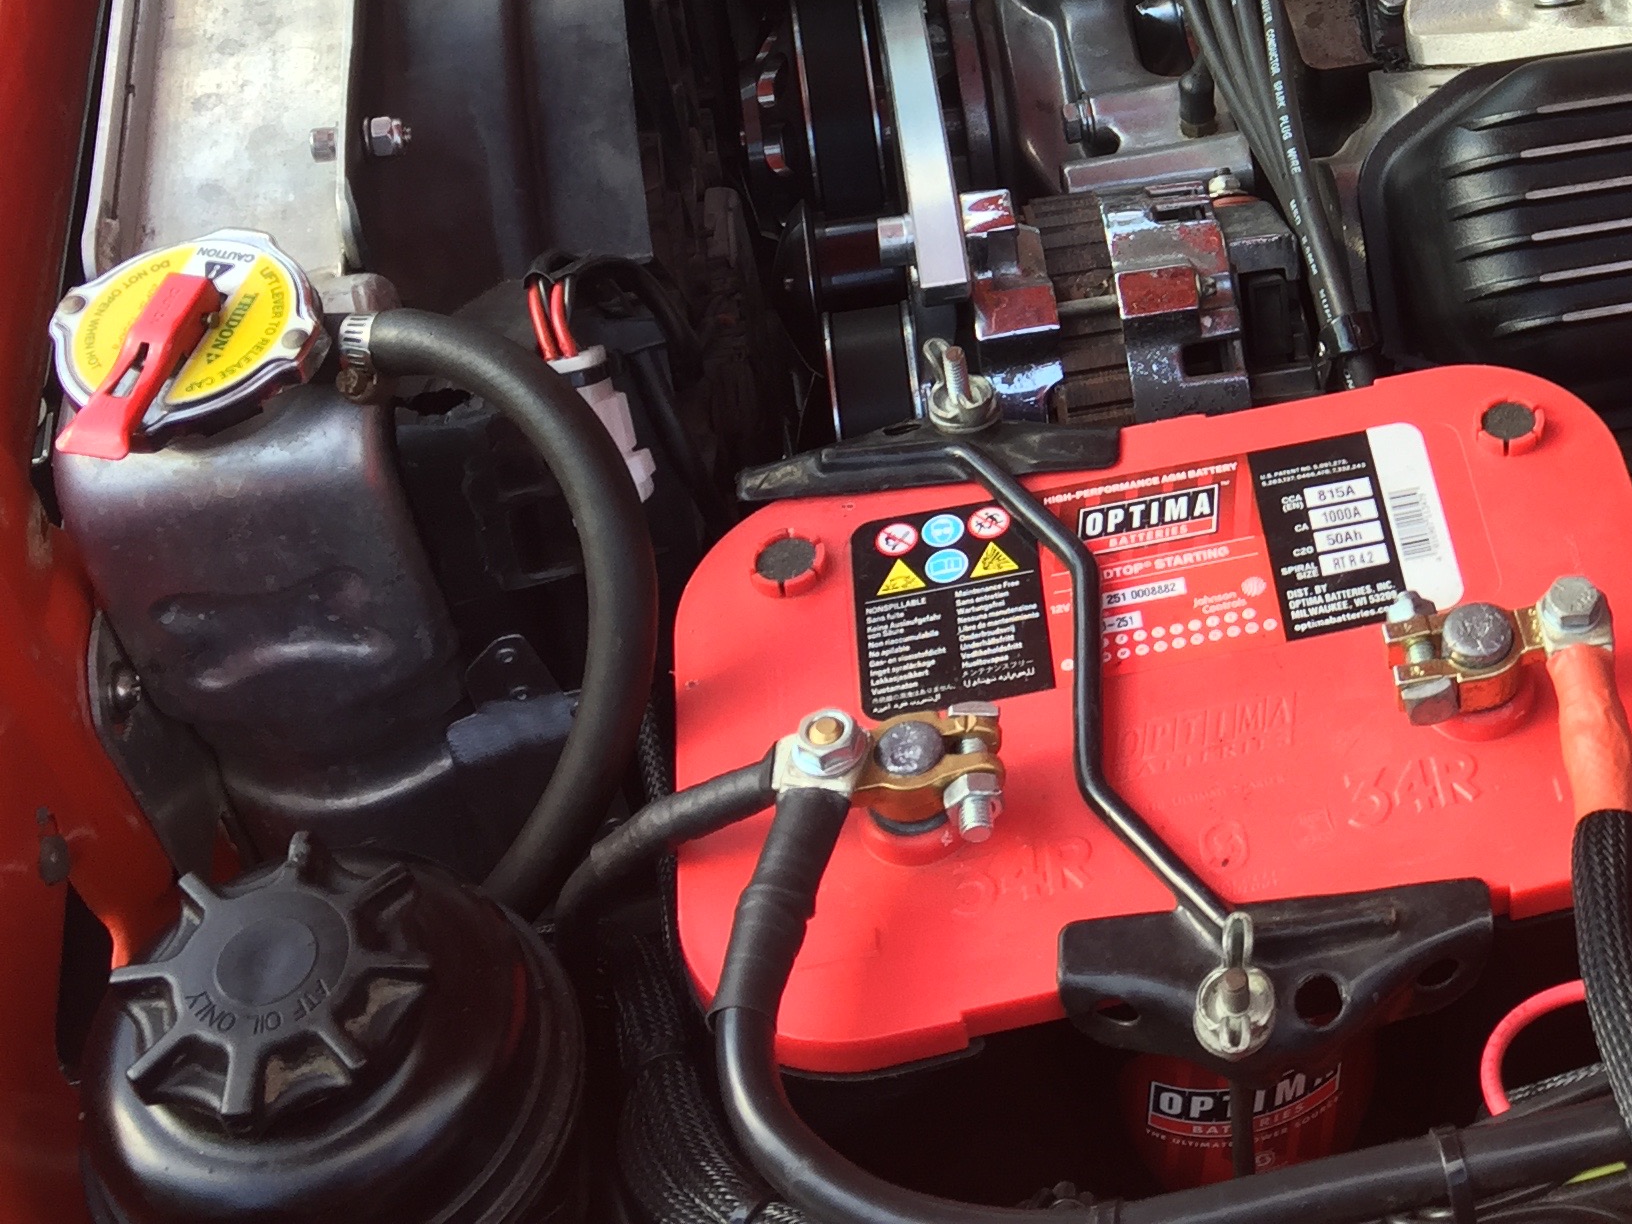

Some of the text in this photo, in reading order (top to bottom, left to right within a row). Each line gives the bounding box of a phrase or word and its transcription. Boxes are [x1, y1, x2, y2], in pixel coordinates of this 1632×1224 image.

[1265, 27, 1281, 77] CONDUCTOR
[1272, 79, 1287, 110] SPARK
[1279, 114, 1293, 142] PLUG
[1286, 146, 1302, 175] WIRE
[197, 246, 256, 263] CAUTION
[152, 259, 171, 273] DO
[121, 269, 149, 291] NOT
[97, 289, 123, 317] OPEN
[184, 265, 286, 393] LIFT LEVER TO RELEASE CAP
[214, 292, 260, 351] TRIDON
[84, 317, 101, 351] WHEN
[86, 350, 103, 370] HOT
[1044, 462, 1238, 506] HIGH-PERFORMANCE AGM BATTERY
[1318, 485, 1356, 502] 815A
[1281, 494, 1303, 505] CCA
[1282, 501, 1304, 513] (EN)
[1085, 492, 1212, 537] OPTIMA
[1322, 506, 1362, 524] 1000A
[1109, 524, 1189, 548] BATTERIES
[1294, 522, 1309, 532] CA
[1327, 530, 1363, 546] 50Ah
[1103, 546, 1230, 579] DTOP® STARTING
[1281, 562, 1319, 576] SPIRAL
[1296, 570, 1320, 580] SIZE
[954, 580, 1020, 597] Maintenance Free
[1106, 582, 1177, 606] 251 0008882
[1286, 583, 1328, 599] DIST. BY
[1289, 579, 1396, 610] OPTIMA BATTERIES, INC.
[865, 597, 926, 615] NONSPILLABLE
[955, 598, 975, 607] Sans
[1050, 603, 1071, 615] 12V
[1193, 590, 1238, 609] Johnson
[1202, 598, 1248, 614] Controls
[1291, 602, 1353, 620] MILWAUKEE,
[1354, 595, 1368, 608] WI
[866, 616, 886, 625] Sans
[867, 624, 889, 633] Keine
[868, 641, 884, 649] Non
[1345, 752, 1482, 828] 34R
[184, 978, 331, 1035] ATF OIL ONLY
[1159, 1072, 1334, 1119] OPIM
[1192, 1102, 1305, 1135] BATRIES
